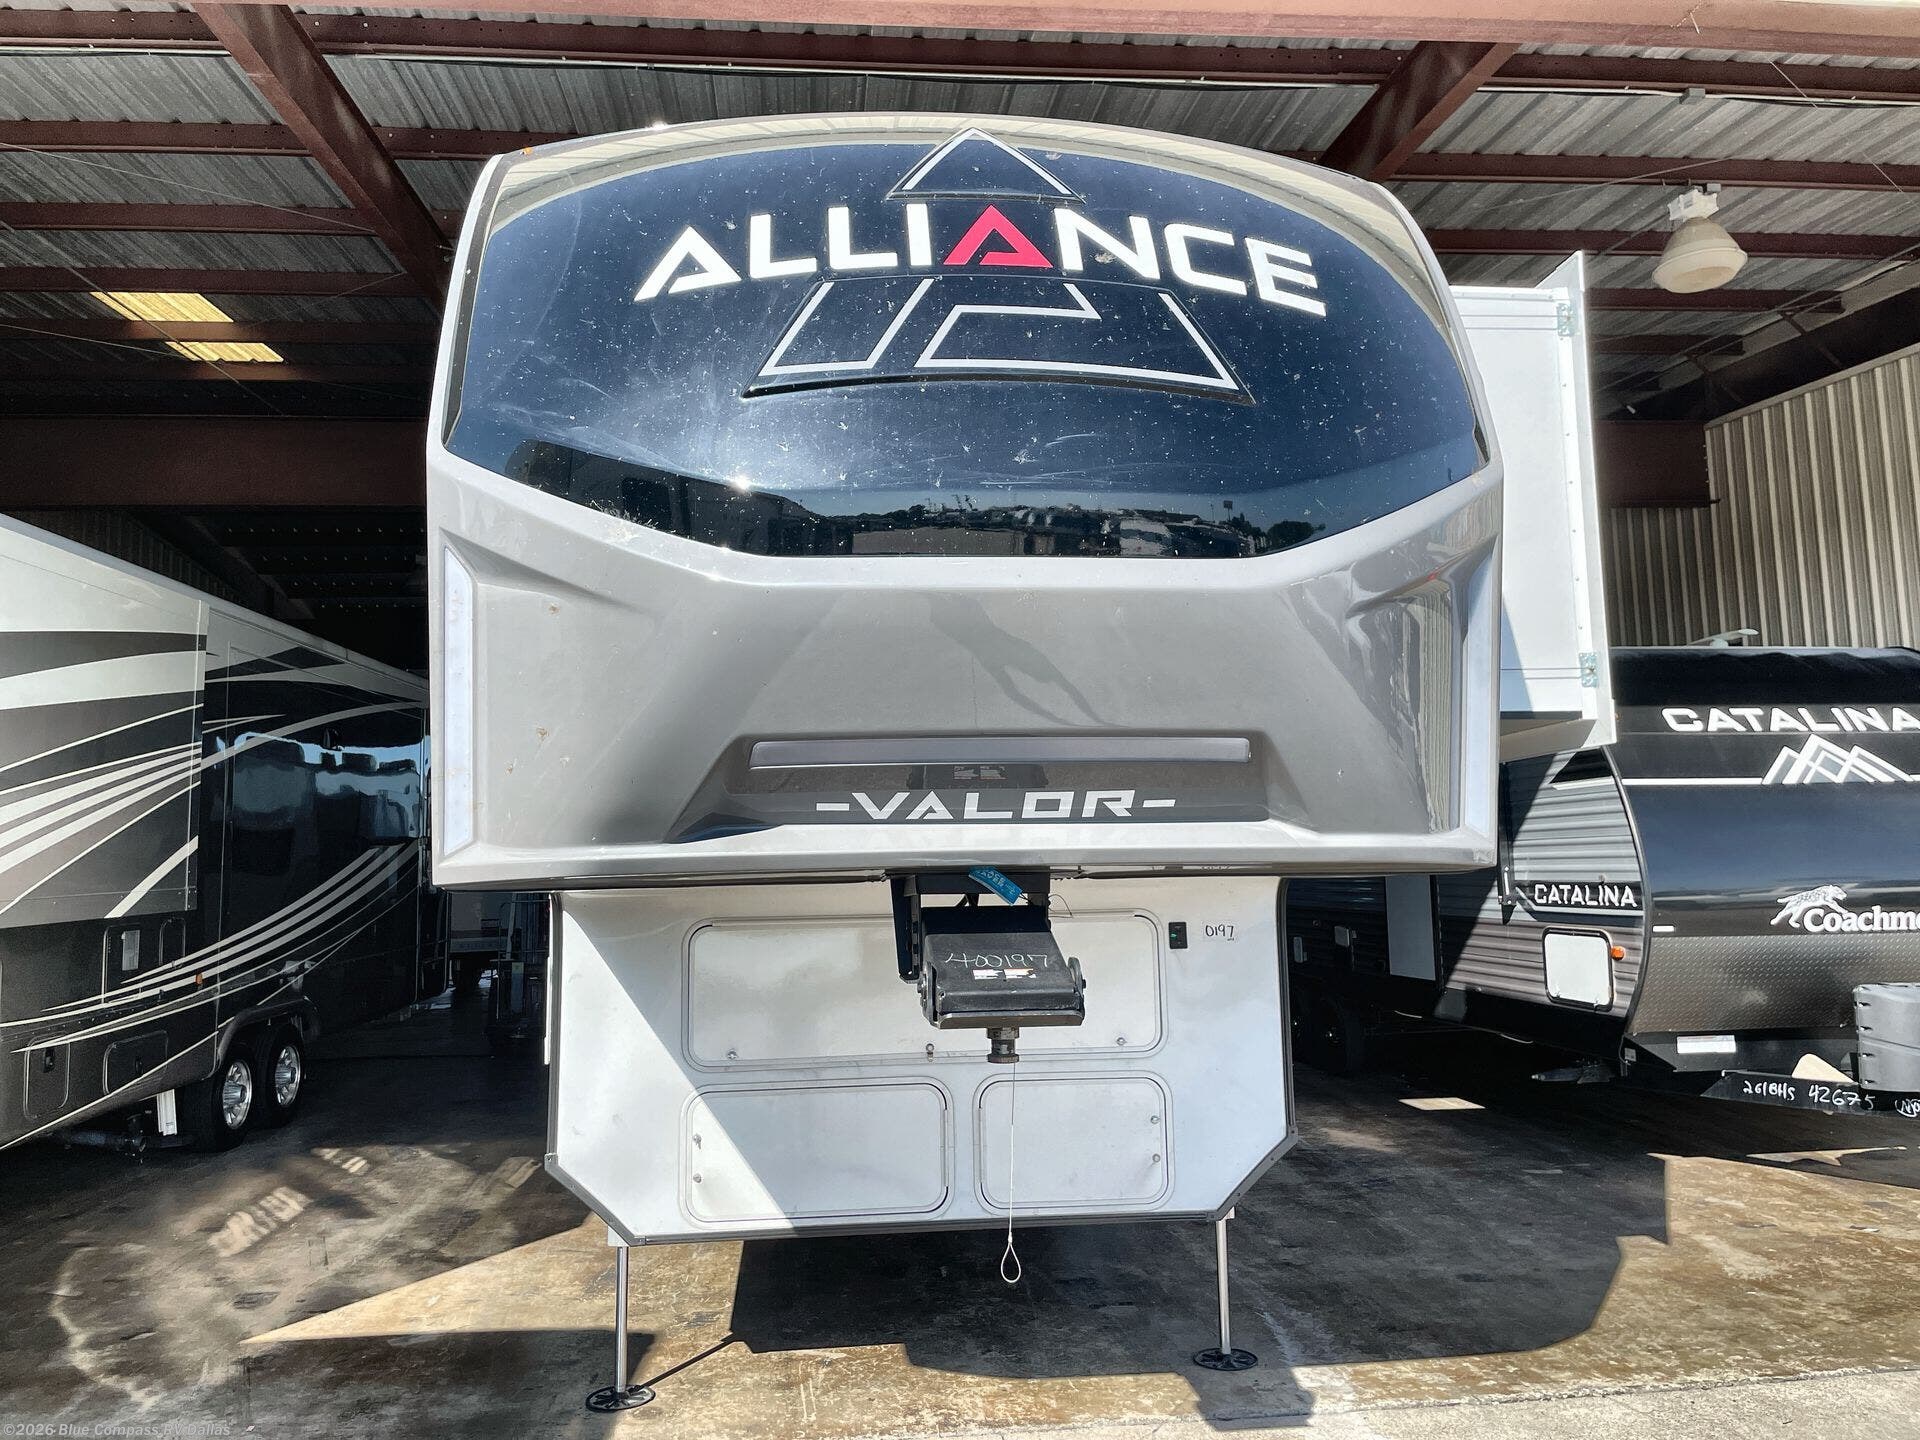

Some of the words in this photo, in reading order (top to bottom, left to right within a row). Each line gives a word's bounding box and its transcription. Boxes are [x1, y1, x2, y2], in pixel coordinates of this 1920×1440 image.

[634, 203, 1327, 317] ALLIANCE
[1661, 707, 1920, 732] CATALINA
[1533, 884, 1638, 907] CATALINA
[1205, 924, 1234, 938] 0197
[1803, 904, 1920, 933] Coachm
